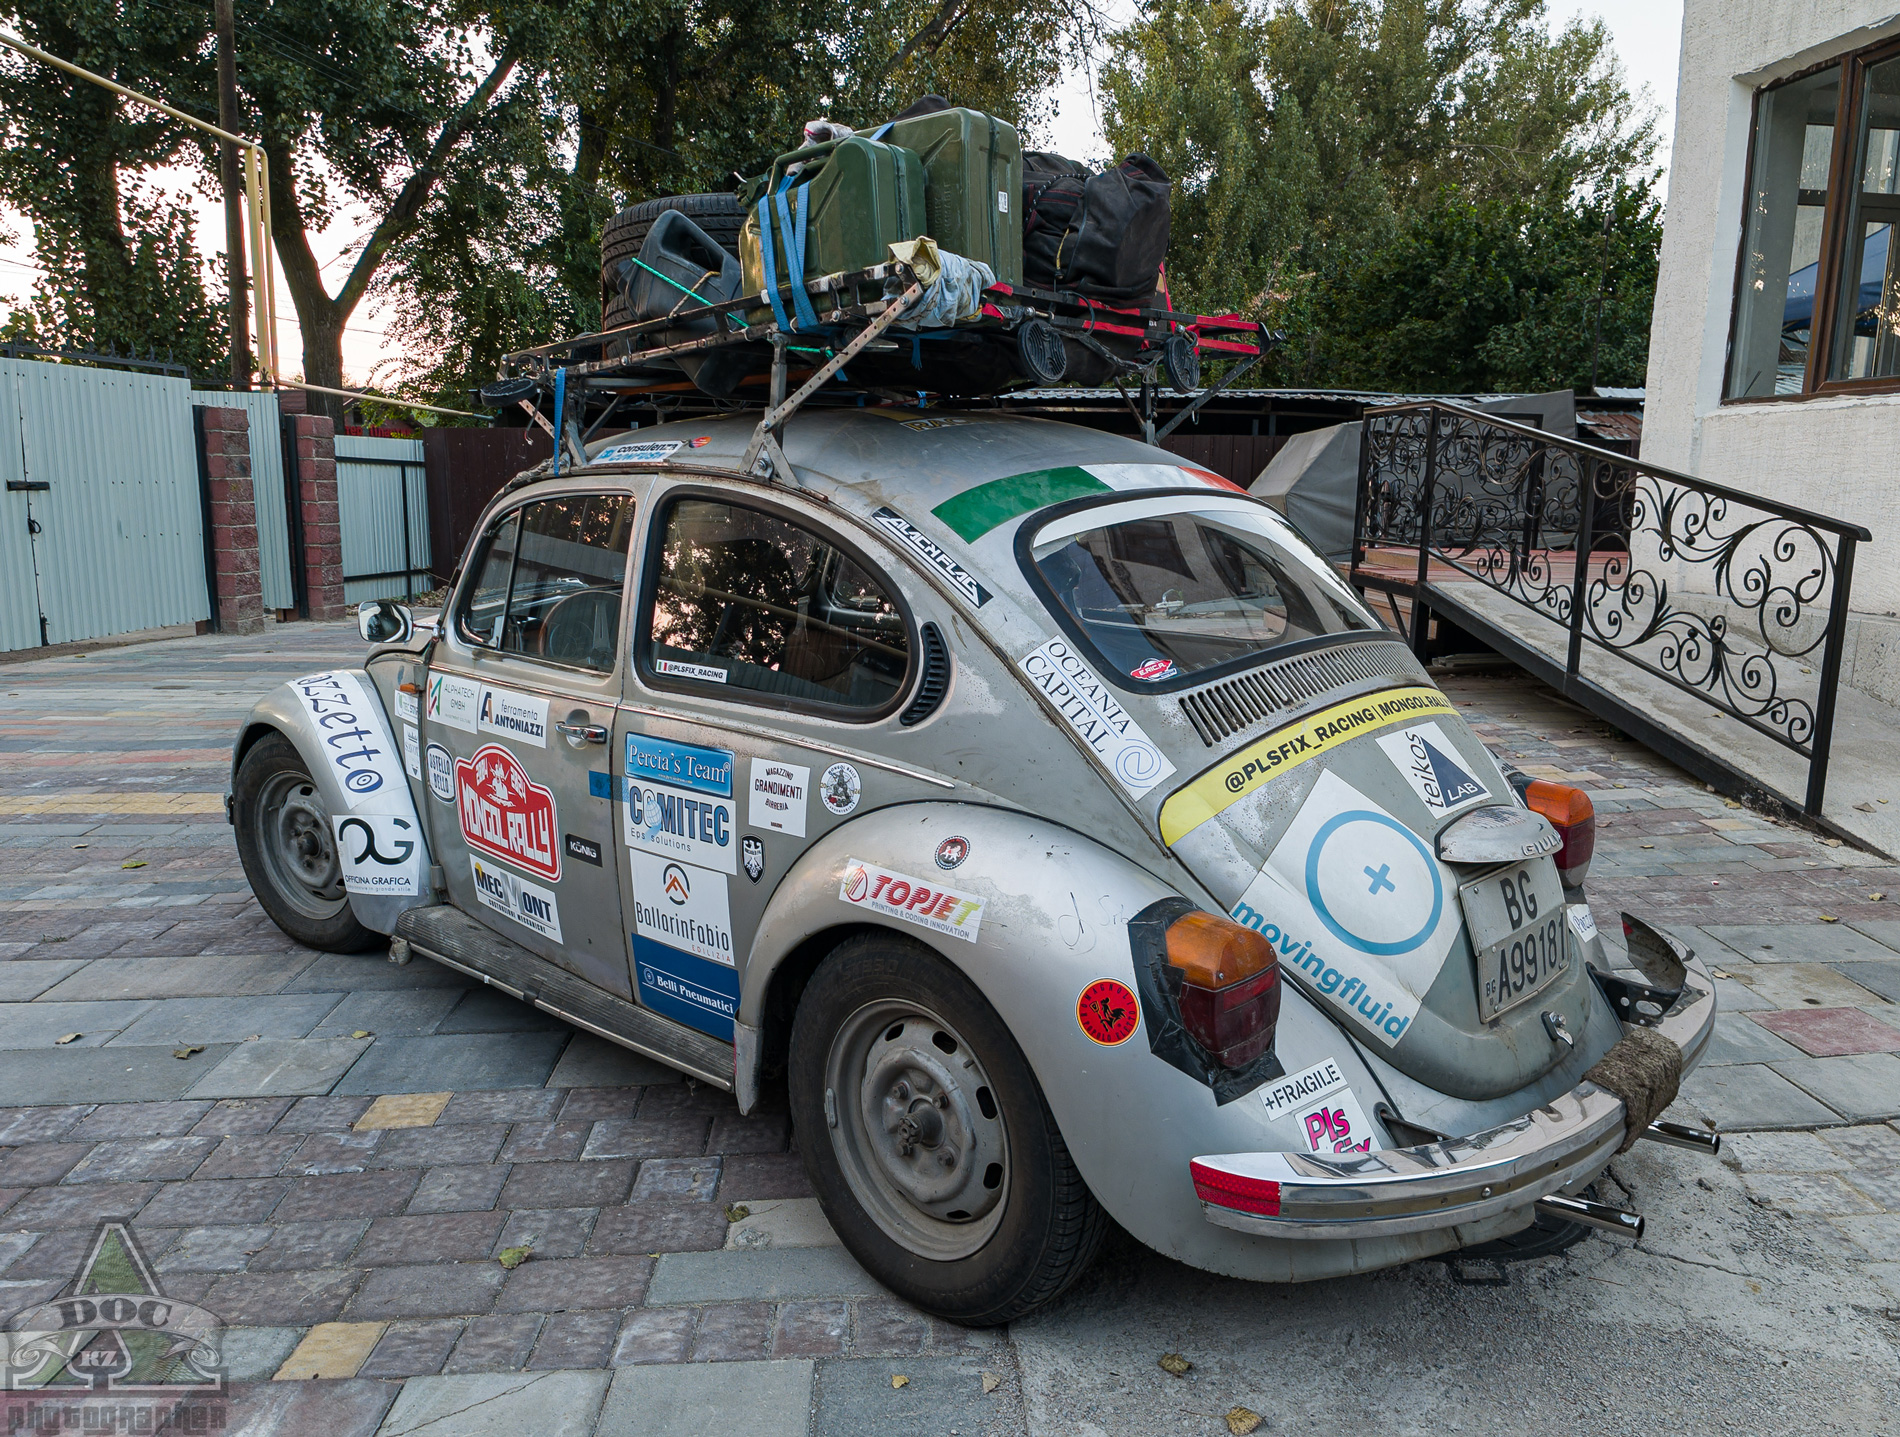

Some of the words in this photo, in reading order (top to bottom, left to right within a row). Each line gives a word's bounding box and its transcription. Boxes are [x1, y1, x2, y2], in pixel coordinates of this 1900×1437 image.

[444, 683, 475, 699] ALPHATECH
[450, 698, 466, 711] GMBH
[1025, 655, 1110, 753] CAPITAL
[1048, 642, 1132, 735] OCEANIA
[494, 713, 544, 738] ANTONIAZZI
[501, 699, 538, 721] ferramenta
[296, 674, 384, 794] ozzetto
[1225, 709, 1376, 794] @PLSFIX_RACING
[1381, 695, 1427, 717] MONGOL
[429, 753, 451, 776] OSTELLO
[628, 743, 682, 774] Percia's
[765, 767, 794, 781] MAGAZZINO
[1404, 731, 1444, 809] teikos
[433, 773, 450, 794] BELLO
[754, 778, 803, 800] GRANDIMENTI
[1447, 782, 1479, 801] LAB
[460, 776, 510, 849] MONGOL
[506, 806, 553, 867] RALLY
[629, 785, 730, 847] COMITEC
[630, 827, 647, 841] Eps
[650, 832, 692, 853] solutions
[345, 874, 371, 885] OFFICINA
[371, 876, 412, 886] GRAFICA
[869, 874, 982, 927] TOPJET
[1499, 869, 1538, 931] BG
[871, 901, 900, 915] PRINTING
[904, 911, 929, 926] CODING
[929, 920, 970, 939] INNOVATION
[691, 944, 732, 963] EDILIZIA
[1231, 901, 1410, 1040] movingfluid
[1499, 912, 1565, 1003] A99181
[656, 974, 678, 992] Belli
[679, 984, 734, 1014] Pneumatici
[1303, 1106, 1351, 1152] Pls
